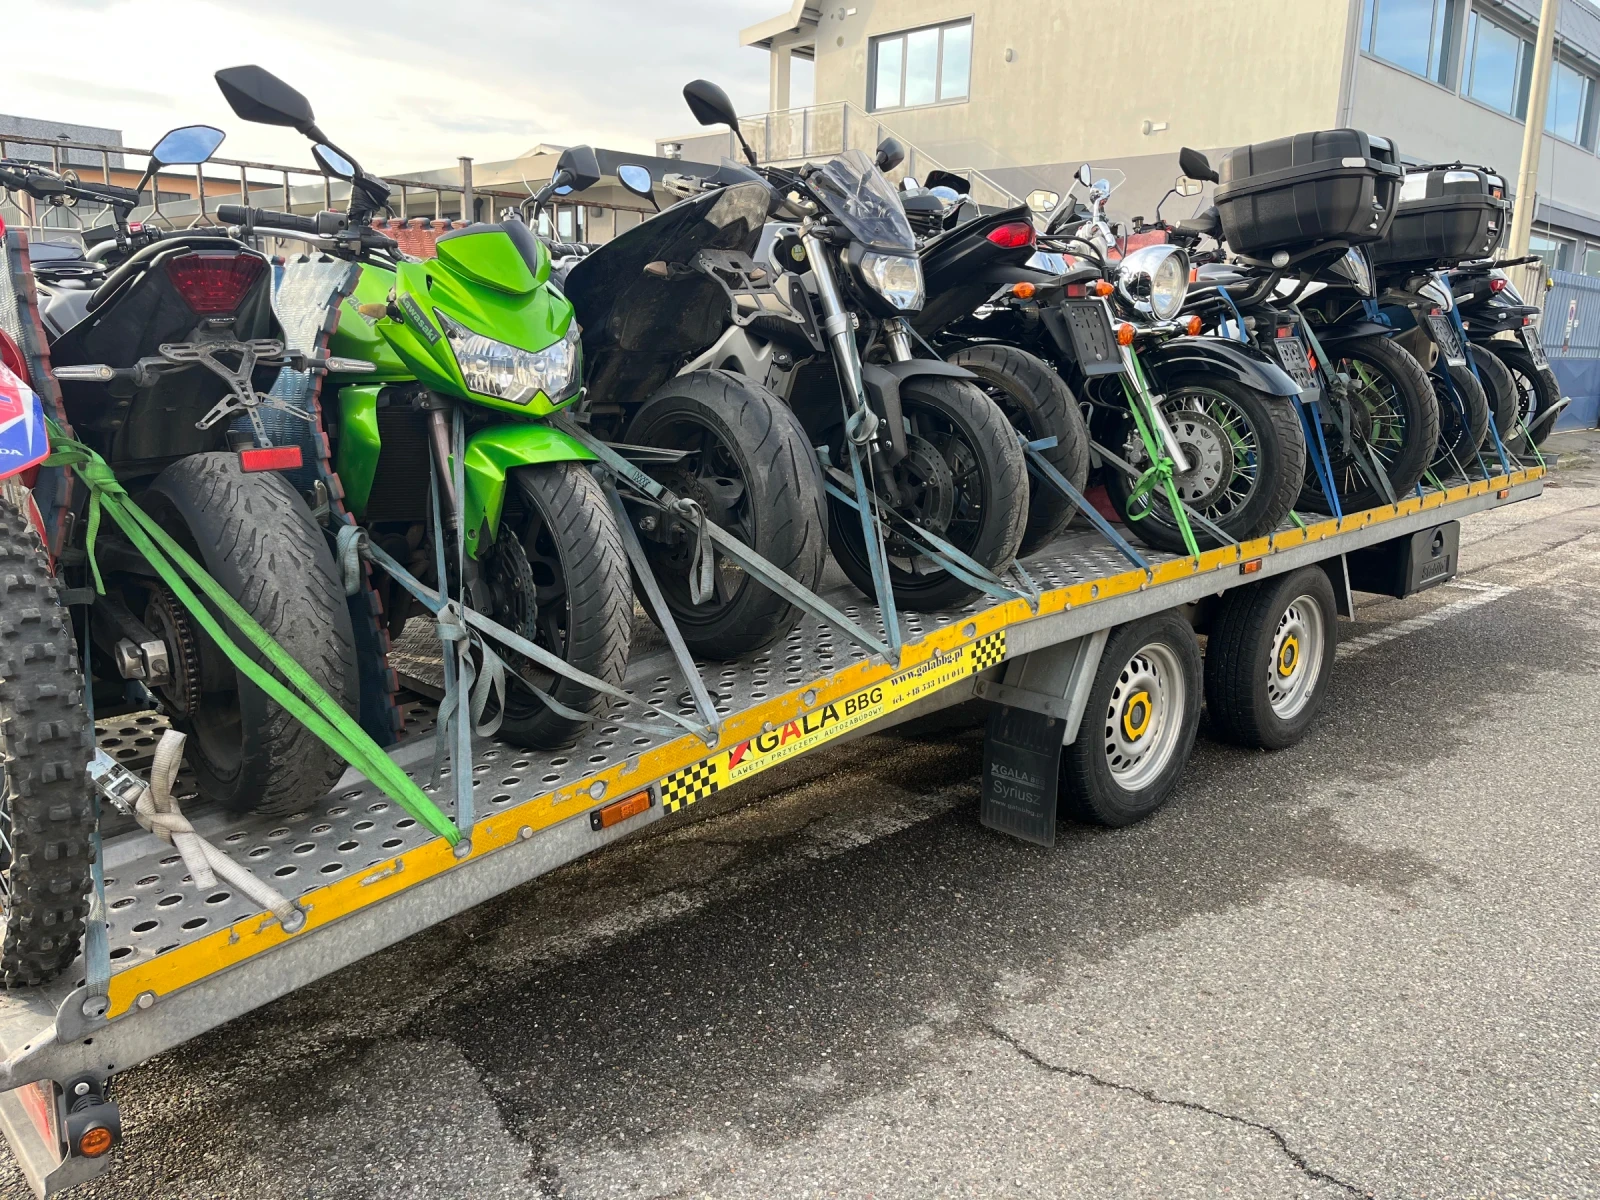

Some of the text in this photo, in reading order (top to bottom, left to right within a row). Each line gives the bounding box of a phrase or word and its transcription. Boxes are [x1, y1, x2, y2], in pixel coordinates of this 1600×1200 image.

[400, 295, 438, 342] Kawasaki
[890, 648, 963, 686] www.galabbg.pl
[756, 687, 883, 753] GALA BBG
[731, 706, 882, 779] LAWETY PRZYCZEPY AUTOZABUDOWY
[993, 780, 1041, 805] Syriusz
[1000, 765, 1029, 781] GALA
